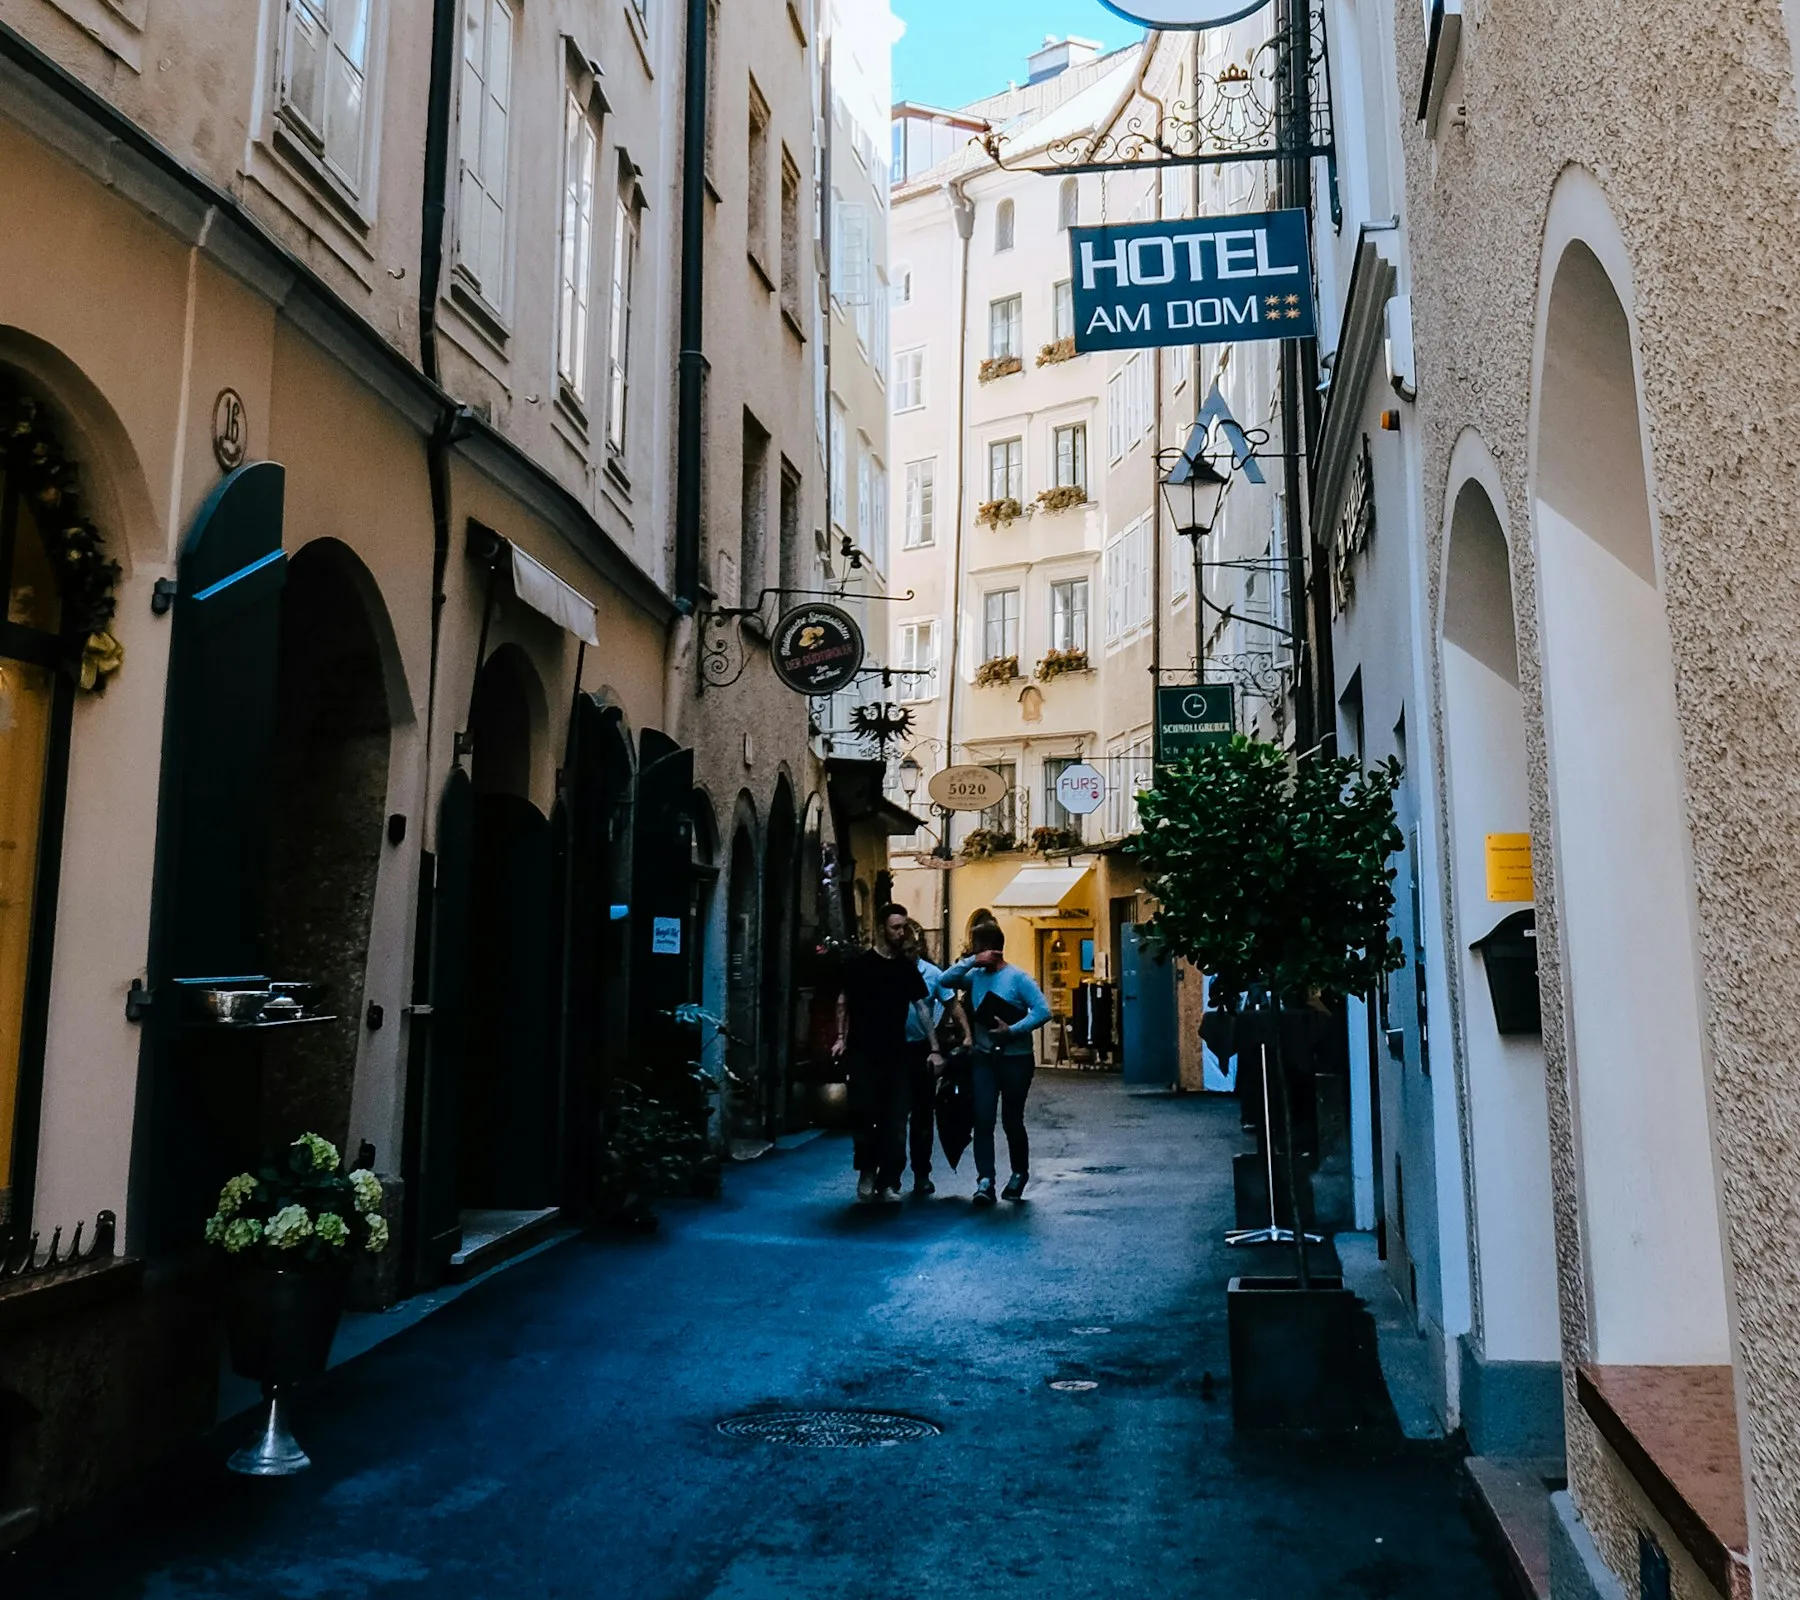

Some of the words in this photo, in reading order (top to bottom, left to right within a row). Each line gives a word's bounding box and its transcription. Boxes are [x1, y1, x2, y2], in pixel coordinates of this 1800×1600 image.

[1080, 228, 1299, 290] HOTEL
[1086, 303, 1151, 335] AM
[1167, 295, 1258, 330] DOM
[948, 783, 986, 795] 5020
[1061, 777, 1099, 790] FURS
